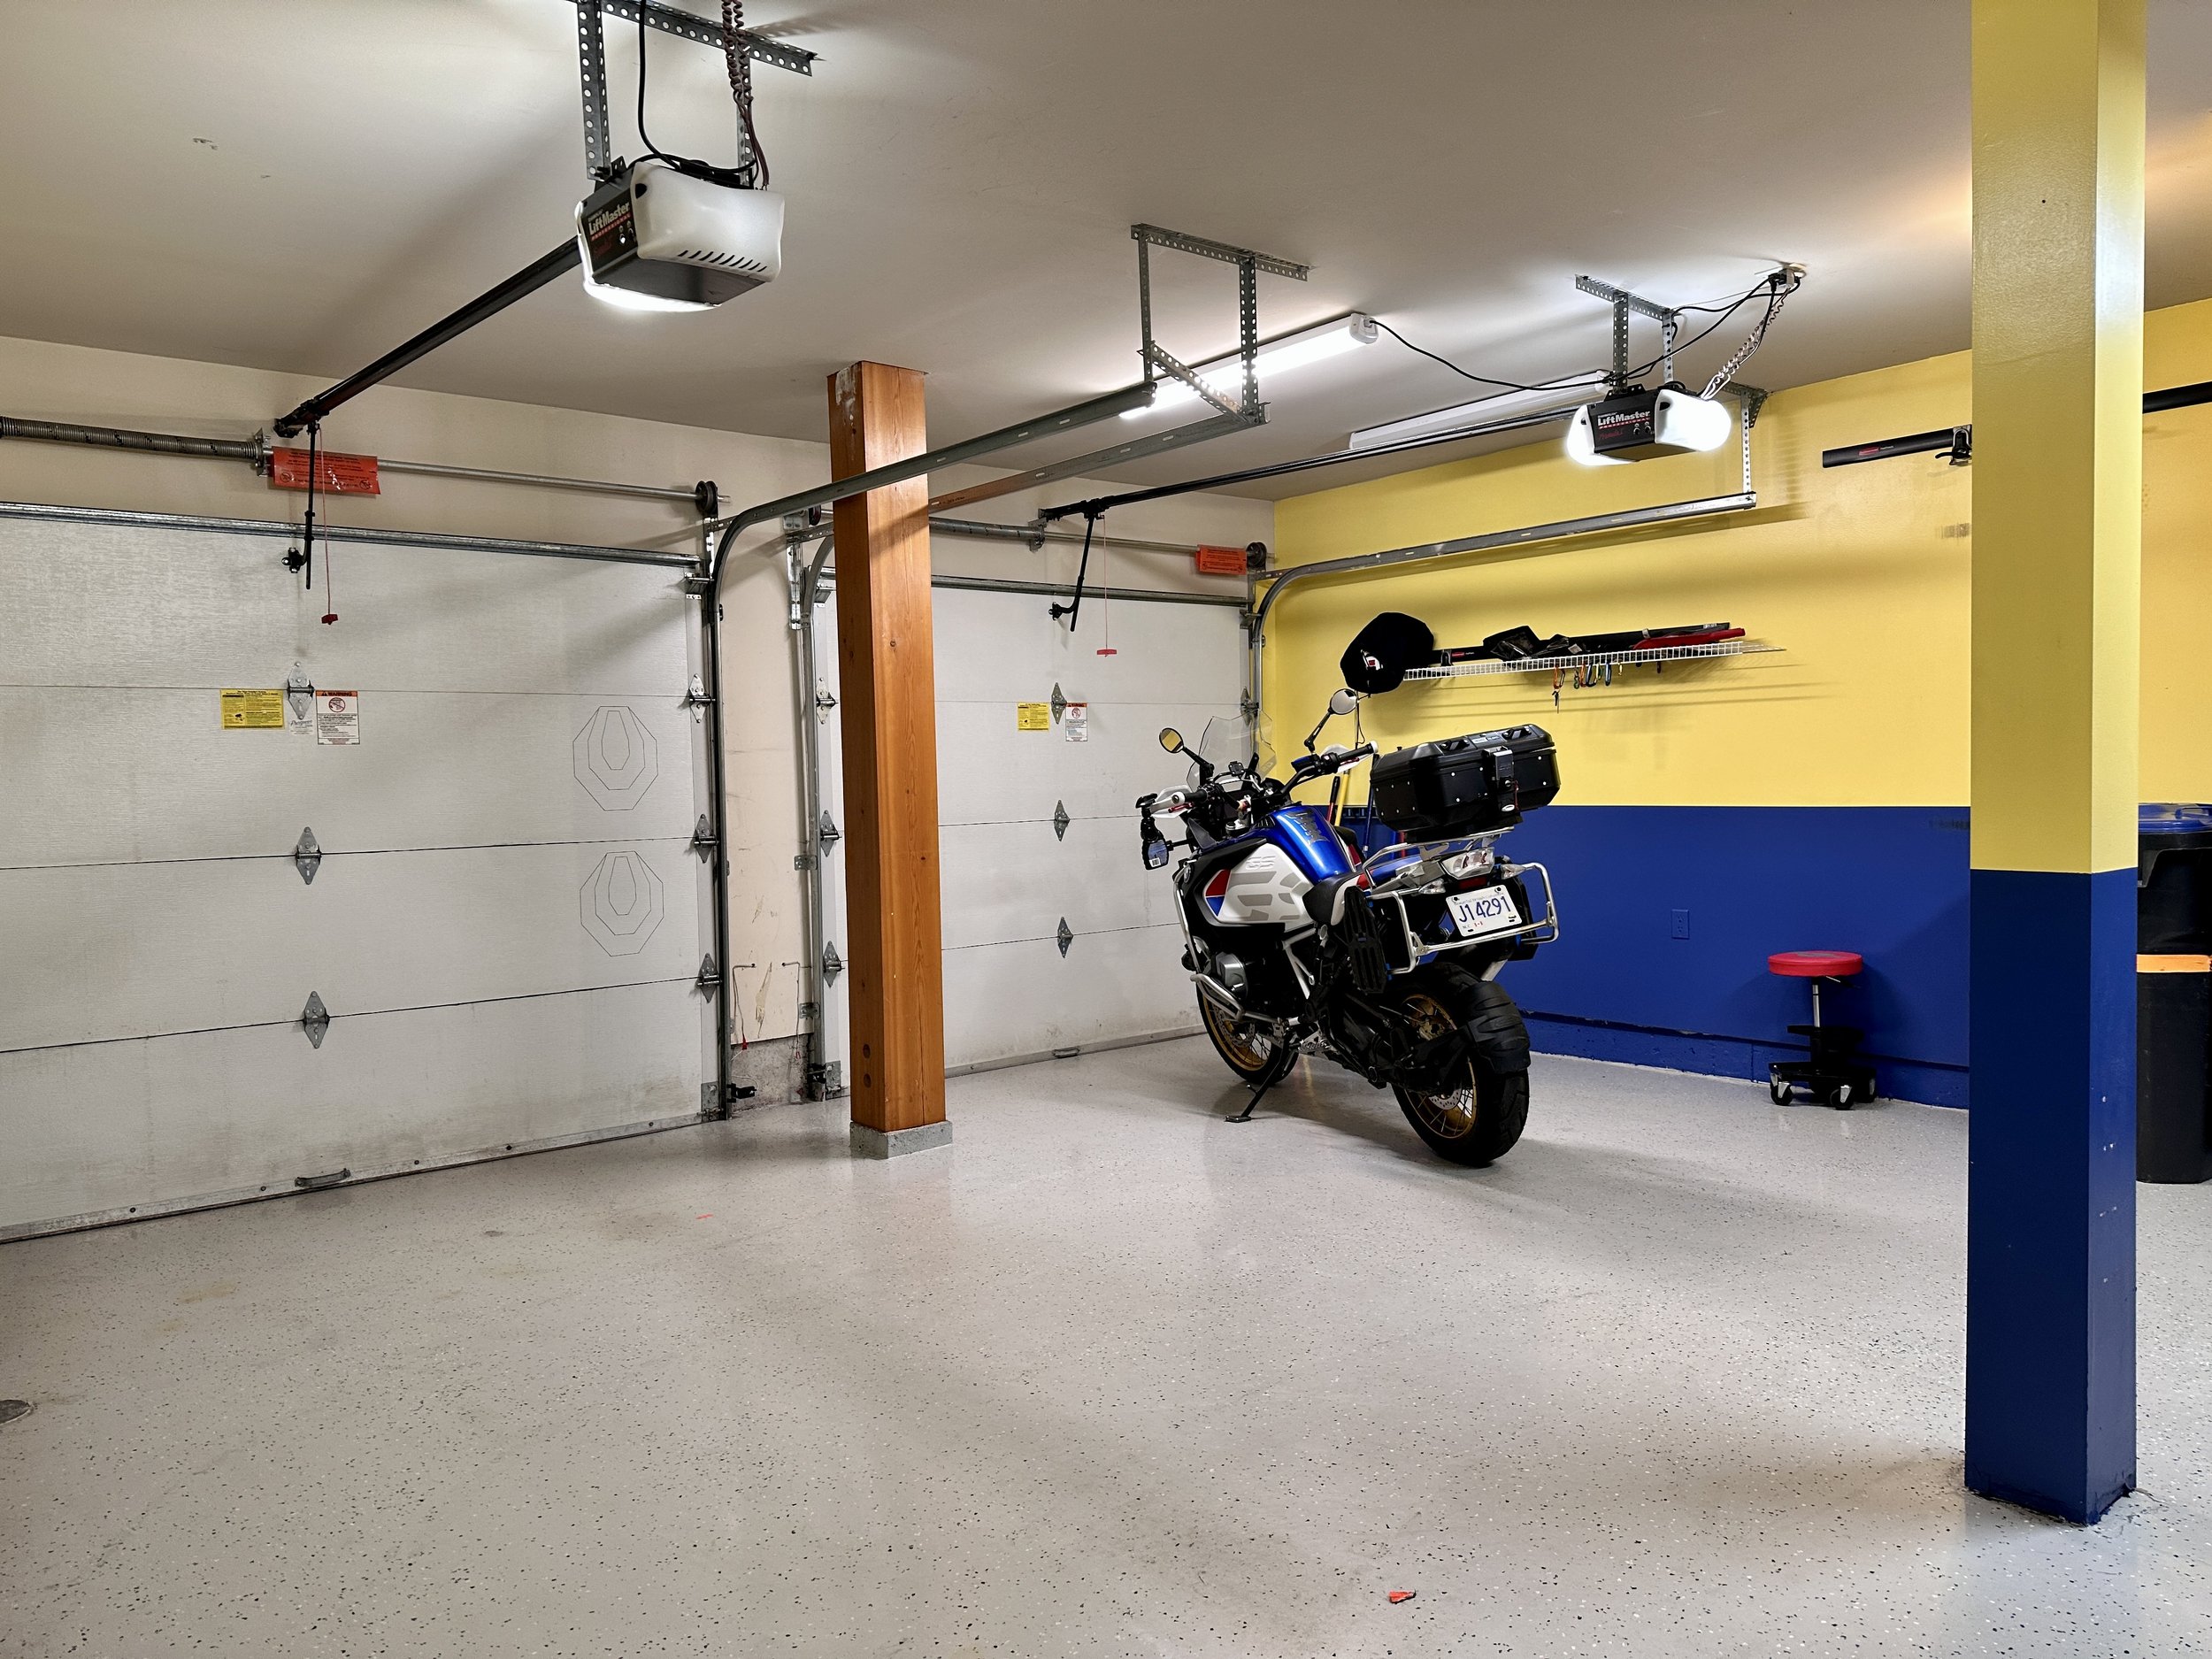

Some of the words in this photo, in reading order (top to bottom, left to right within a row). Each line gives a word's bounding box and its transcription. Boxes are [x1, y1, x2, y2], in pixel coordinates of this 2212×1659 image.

[588, 202, 630, 235] LiftMaster
[1597, 411, 1651, 426] LiftMaster
[1246, 855, 1277, 870] GS
[1459, 895, 1511, 923] J14291
